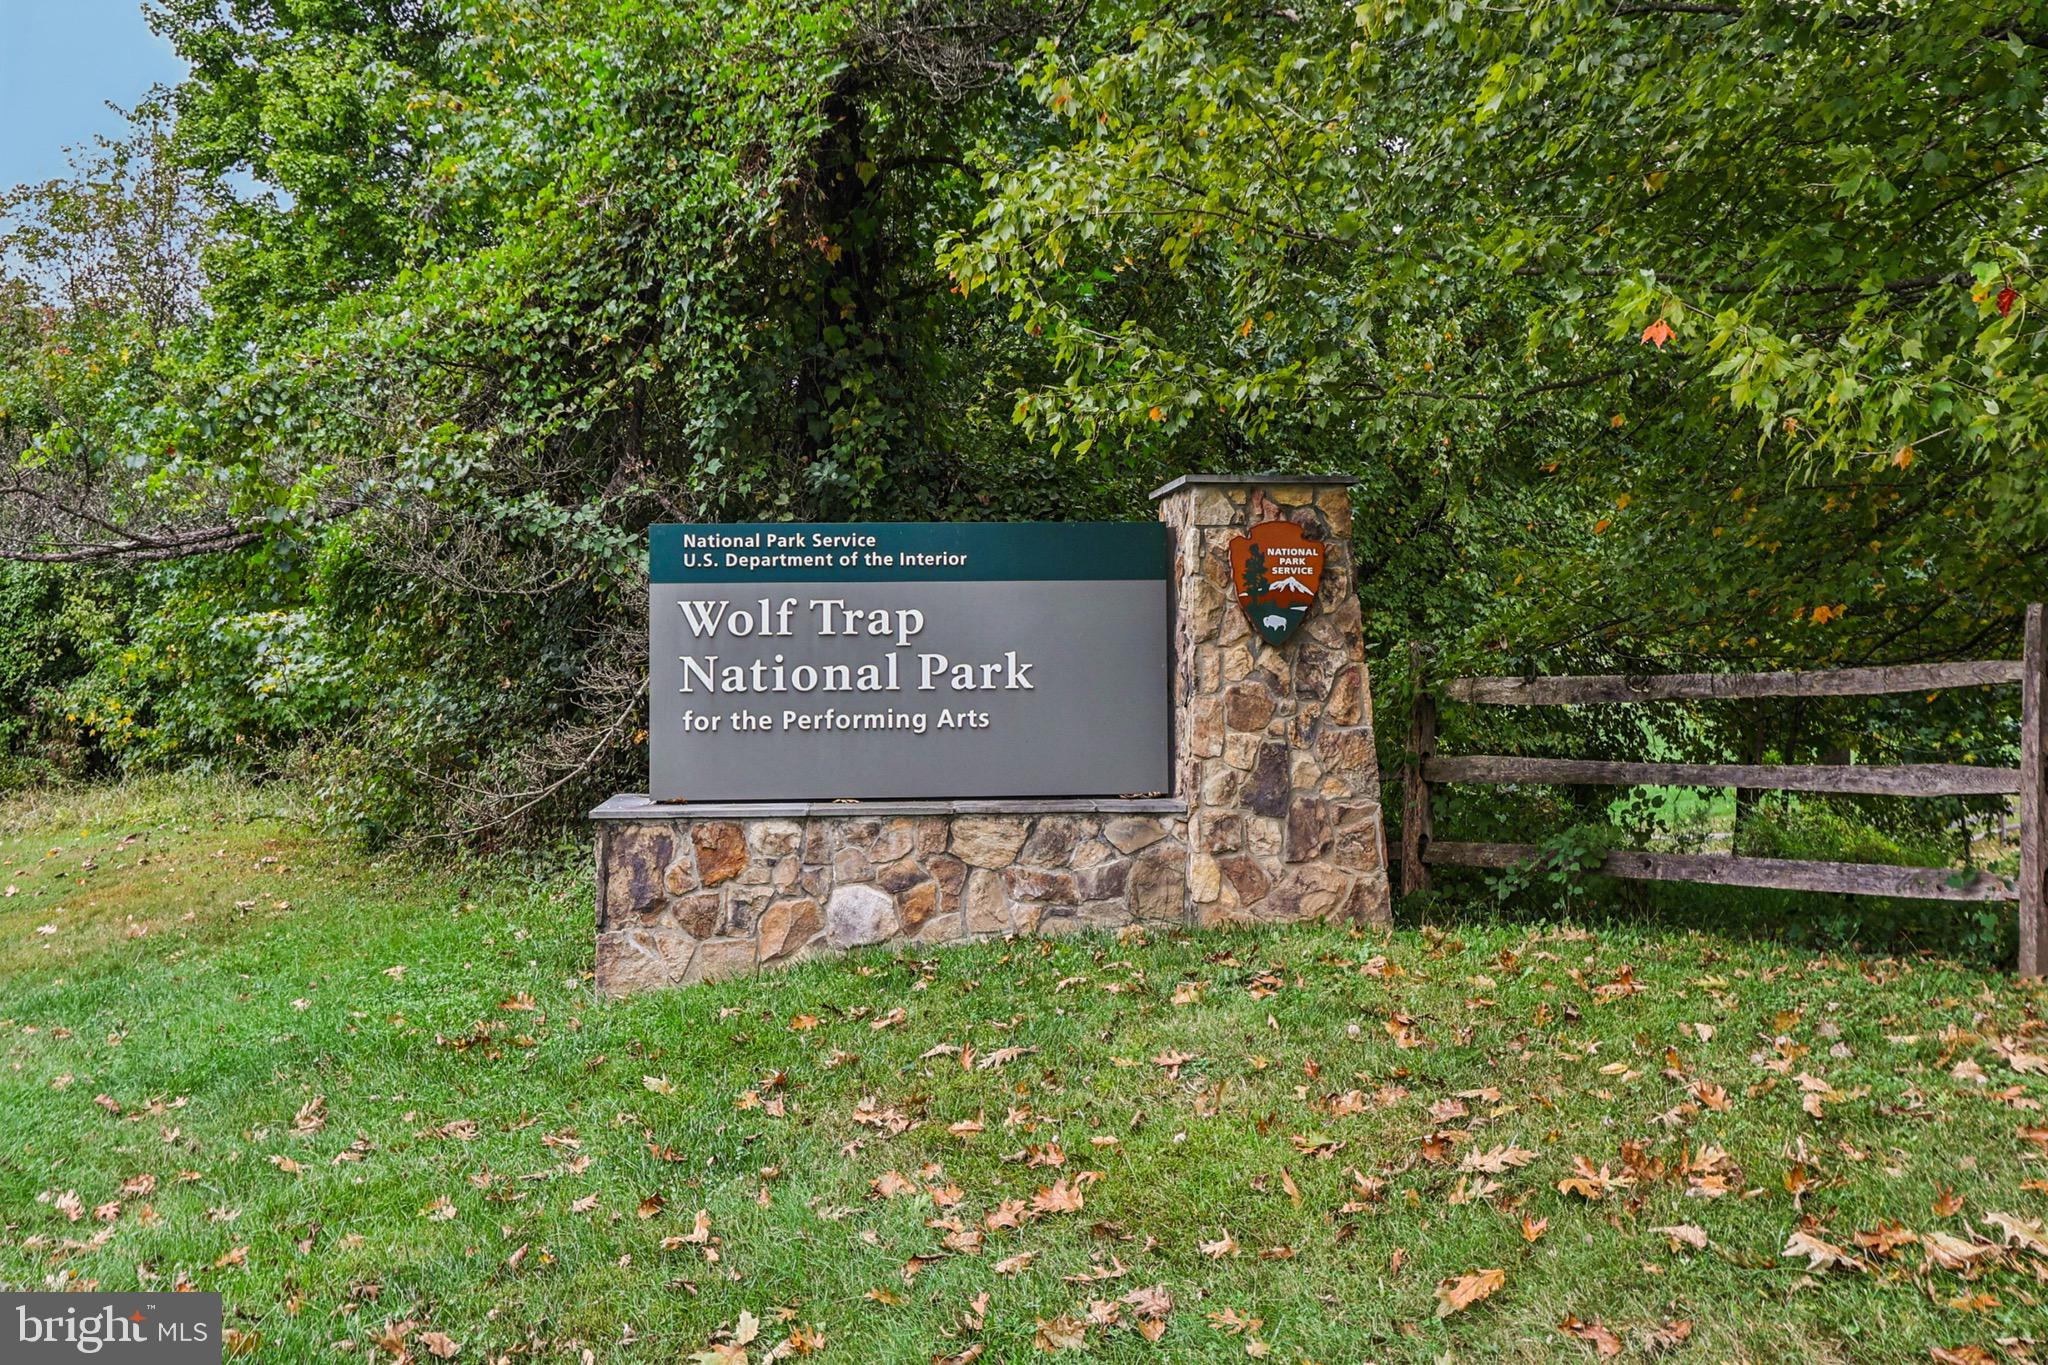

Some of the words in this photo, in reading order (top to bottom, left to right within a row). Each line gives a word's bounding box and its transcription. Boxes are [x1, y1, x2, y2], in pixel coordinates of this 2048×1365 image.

[683, 532, 760, 548] National
[767, 532, 806, 548] Park
[812, 532, 876, 547] Service
[683, 553, 718, 568] U.S.
[725, 553, 833, 570] Department
[839, 551, 858, 567] of
[863, 551, 894, 566] the
[900, 551, 968, 566] Interior
[1267, 548, 1318, 556] NATIONAL
[1279, 557, 1306, 565] PARK
[1272, 566, 1313, 575] SERVICE
[677, 597, 798, 637] Wolf
[809, 599, 924, 646] Trap
[678, 652, 900, 692] National
[917, 650, 1034, 690] Park
[682, 710, 721, 731] for
[730, 709, 772, 730] the
[783, 708, 927, 734] Performing
[936, 708, 990, 728] Arts
